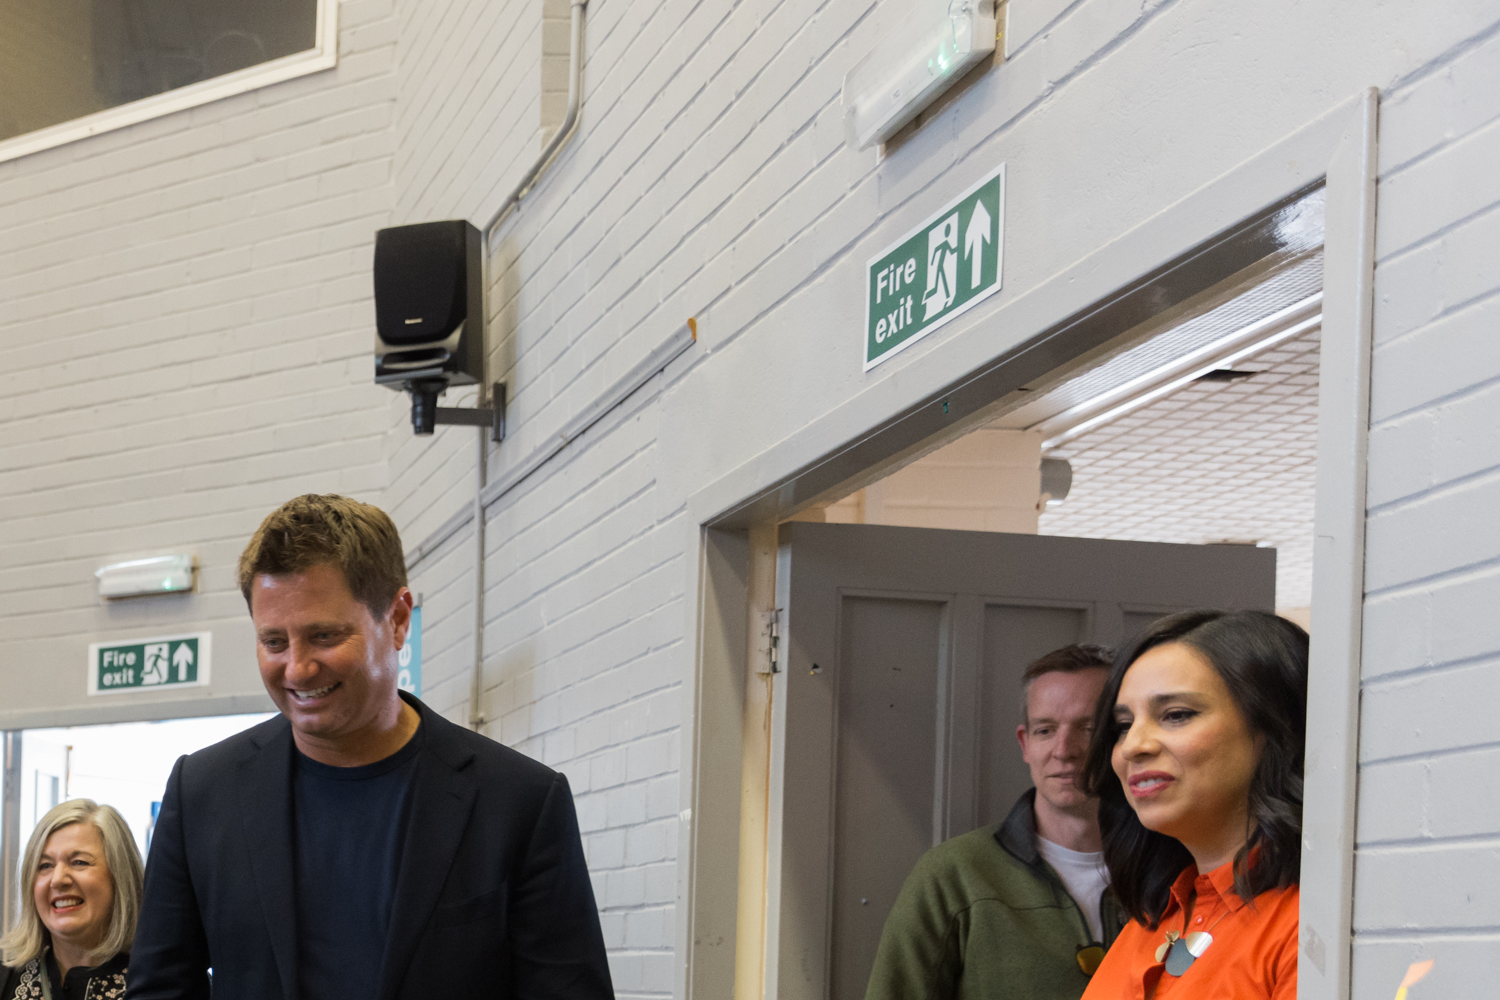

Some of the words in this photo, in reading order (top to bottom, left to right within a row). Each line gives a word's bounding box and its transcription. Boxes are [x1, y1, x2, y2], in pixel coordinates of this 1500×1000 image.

[876, 257, 917, 304] Fire
[875, 294, 913, 343] exit
[103, 650, 137, 668] Fire
[103, 668, 135, 686] exit
